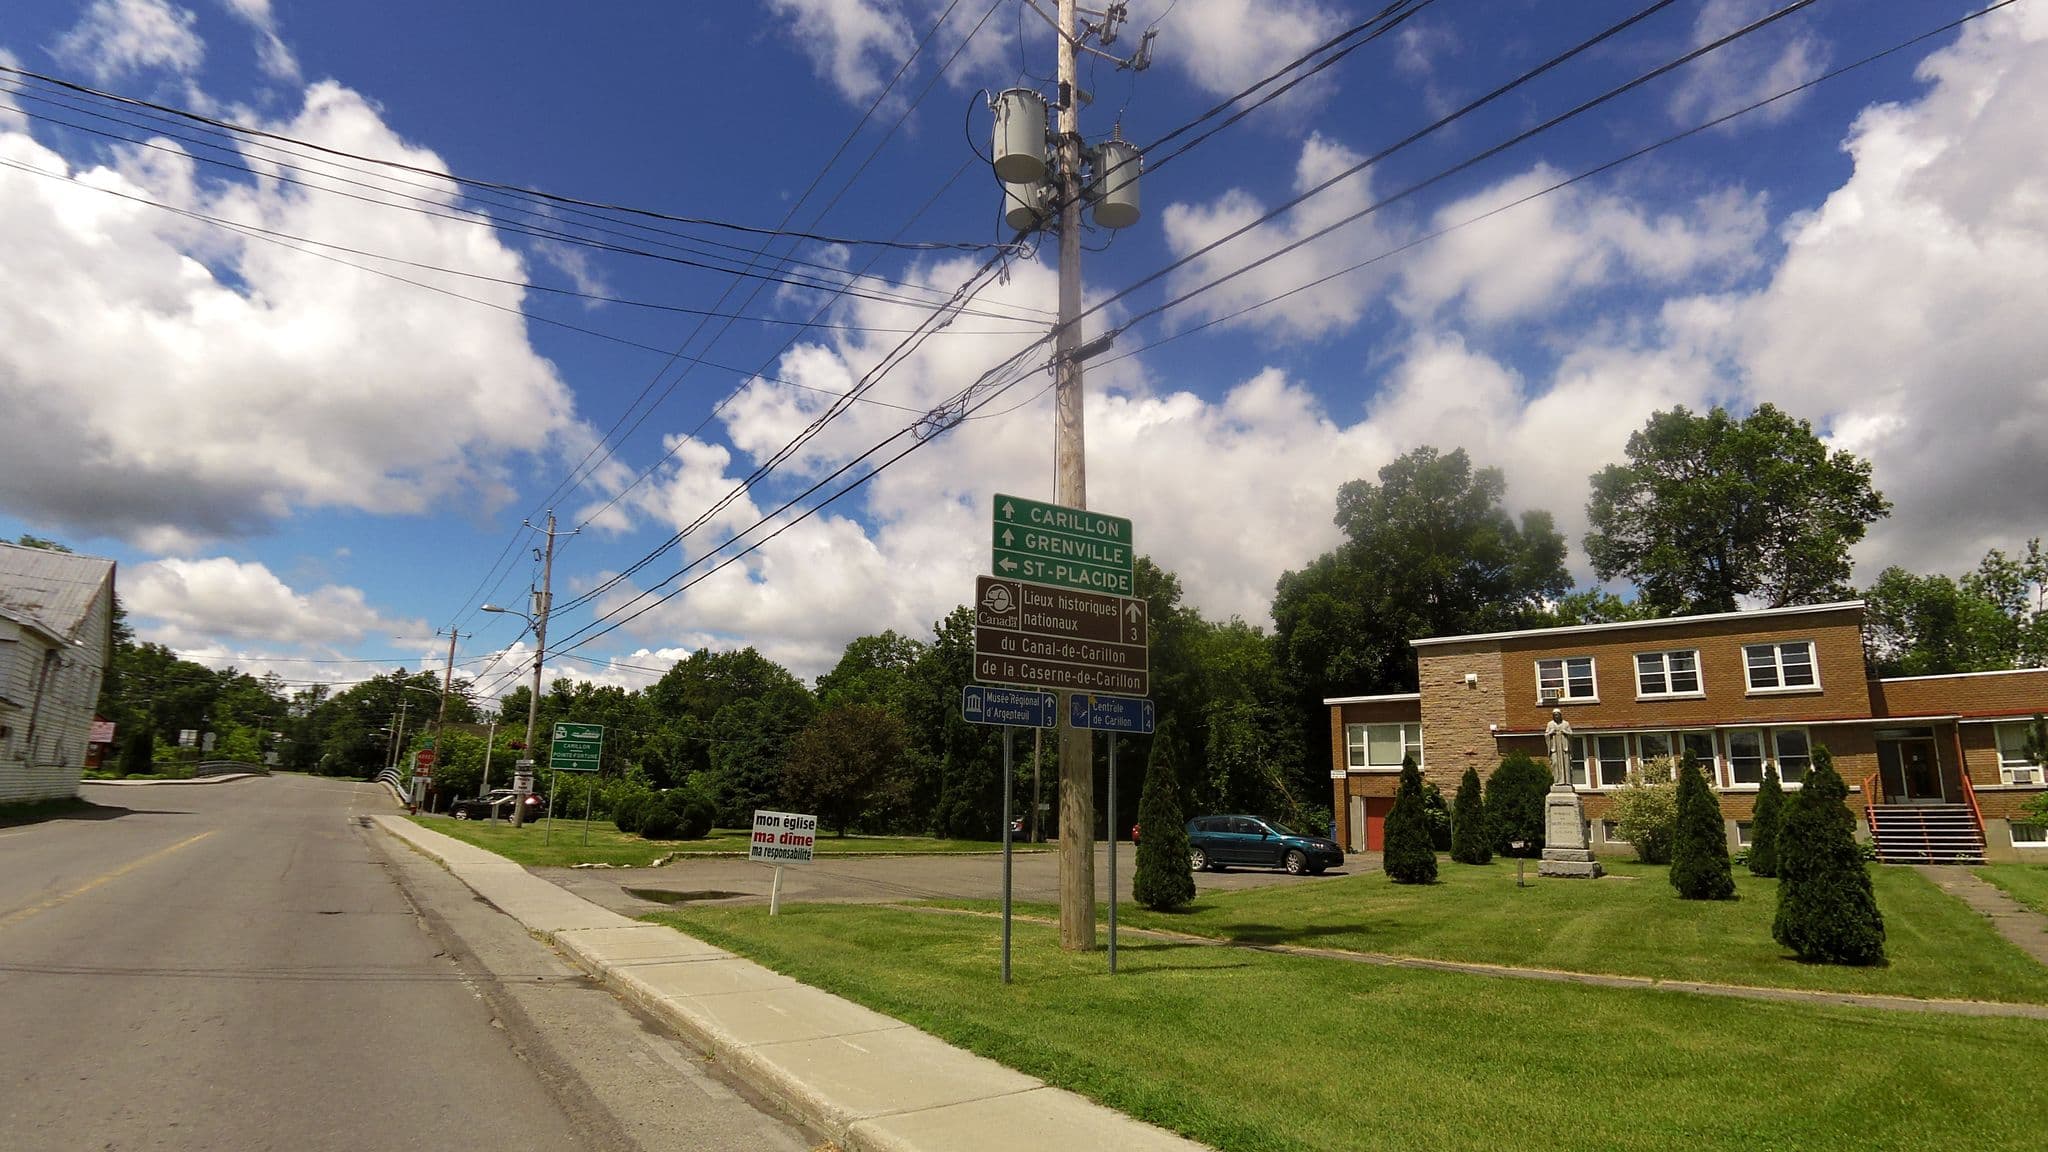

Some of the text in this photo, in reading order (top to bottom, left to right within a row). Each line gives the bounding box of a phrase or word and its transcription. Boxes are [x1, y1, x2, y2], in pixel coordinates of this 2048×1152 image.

[1031, 508, 1119, 537] CARILLON
[1025, 533, 1123, 564] GRENVILLE
[1023, 560, 1128, 590] ST-PLACIDE
[1024, 590, 1117, 616] Lieux historiques
[978, 611, 1018, 628] Canada
[1024, 612, 1078, 631] nationaux
[1130, 627, 1138, 641] 3
[1001, 636, 1126, 663] du Canal-de-Carillon
[982, 660, 1140, 689] de la Caserne-de-Carillon
[1046, 716, 1053, 726] 3
[1093, 714, 1132, 727] de Carillon
[1145, 719, 1151, 728] 4
[756, 815, 815, 830] mon église
[753, 832, 813, 847] ma dîme
[752, 845, 811, 861] ma responsabilité
